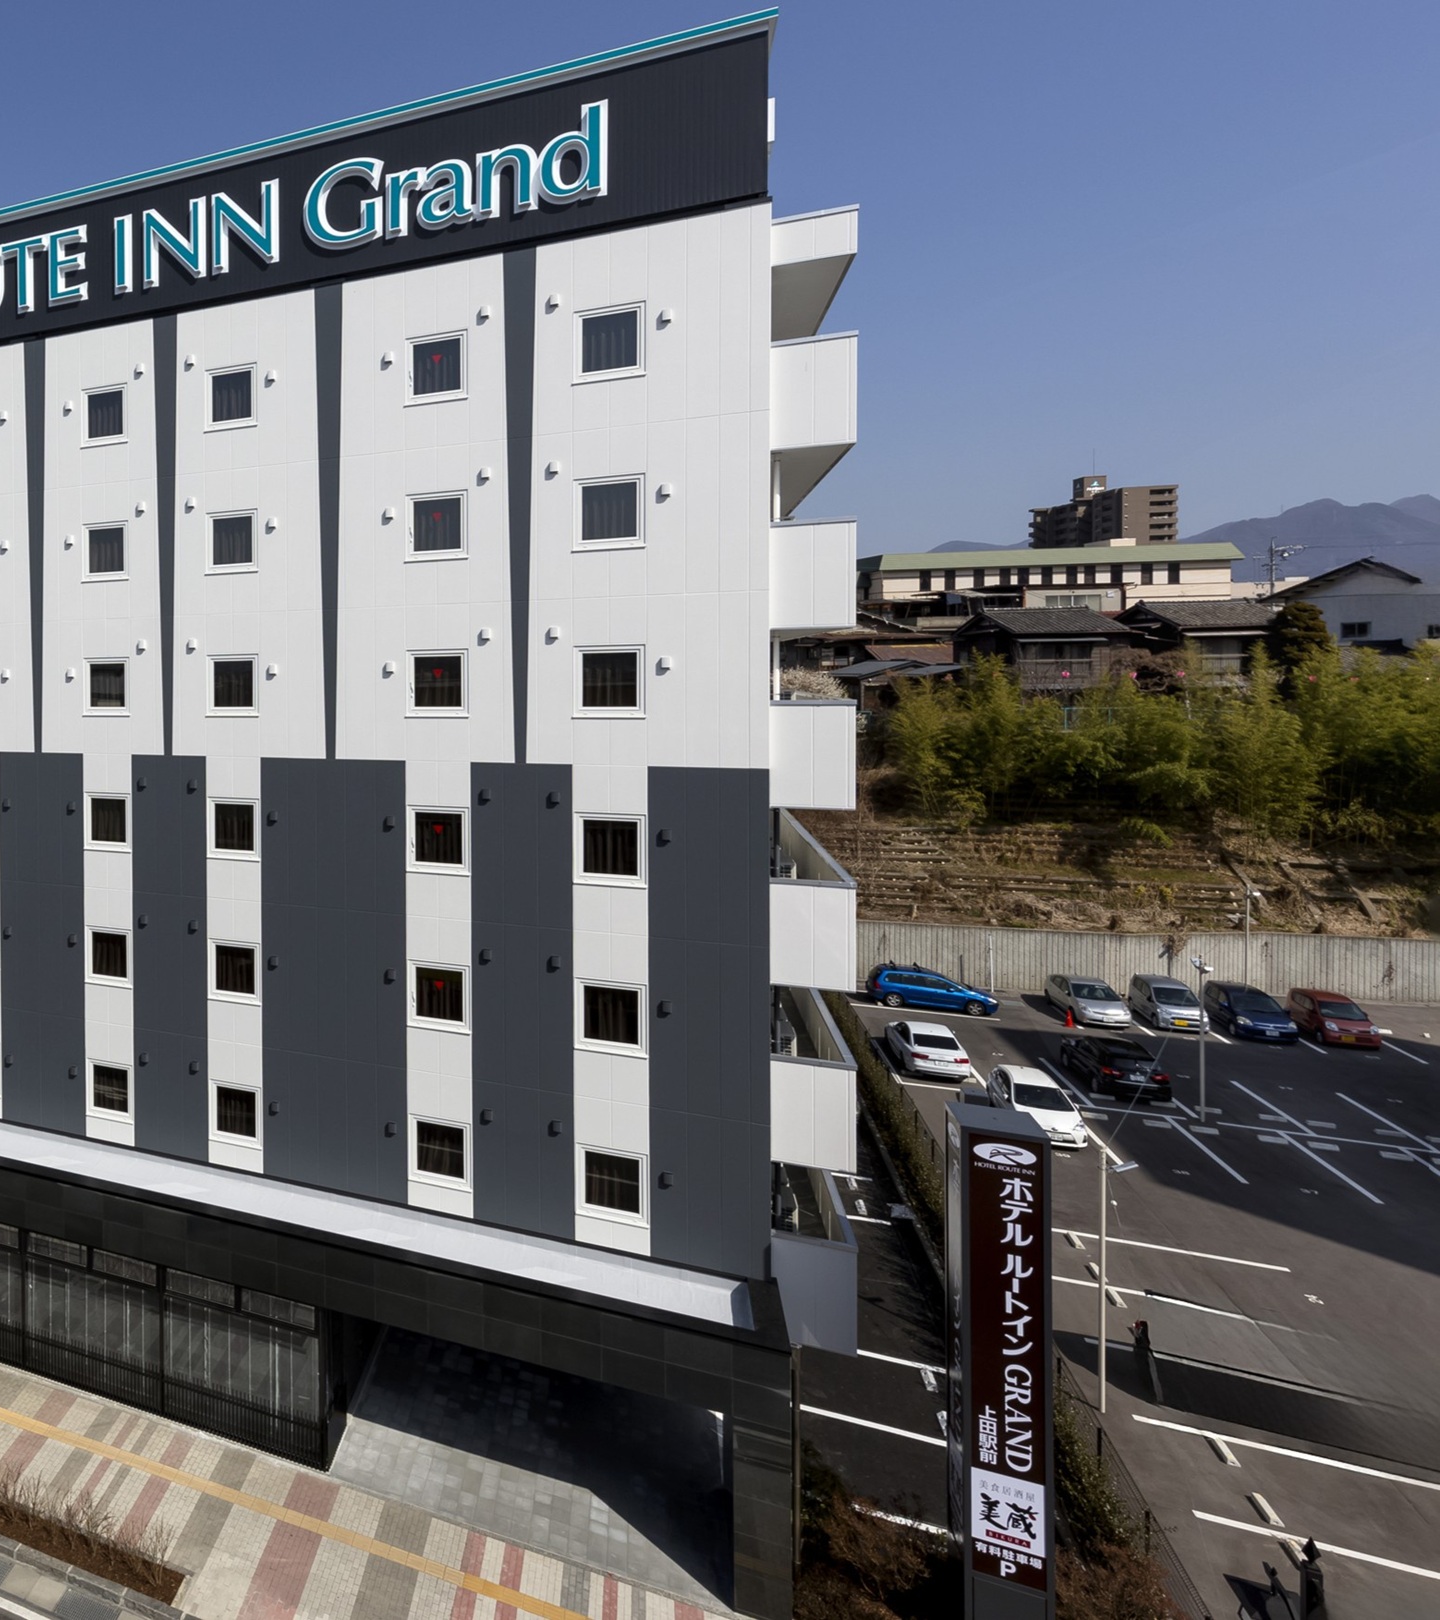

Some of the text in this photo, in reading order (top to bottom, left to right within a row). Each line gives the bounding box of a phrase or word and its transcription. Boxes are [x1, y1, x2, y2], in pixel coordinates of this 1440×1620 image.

[114, 178, 280, 295] INN
[303, 98, 609, 250] Grand
[974, 1161, 1036, 1176] HOTEL ROUTE INN
[999, 1177, 1034, 1473] ホテル ルートイン GRAND
[978, 1404, 998, 1465] 上田駅前
[980, 1479, 1035, 1503] 美食居酒屋
[988, 1531, 1028, 1547] BIKURA
[975, 1541, 1042, 1570] 有料駐車場
[1001, 1560, 1017, 1577] P
